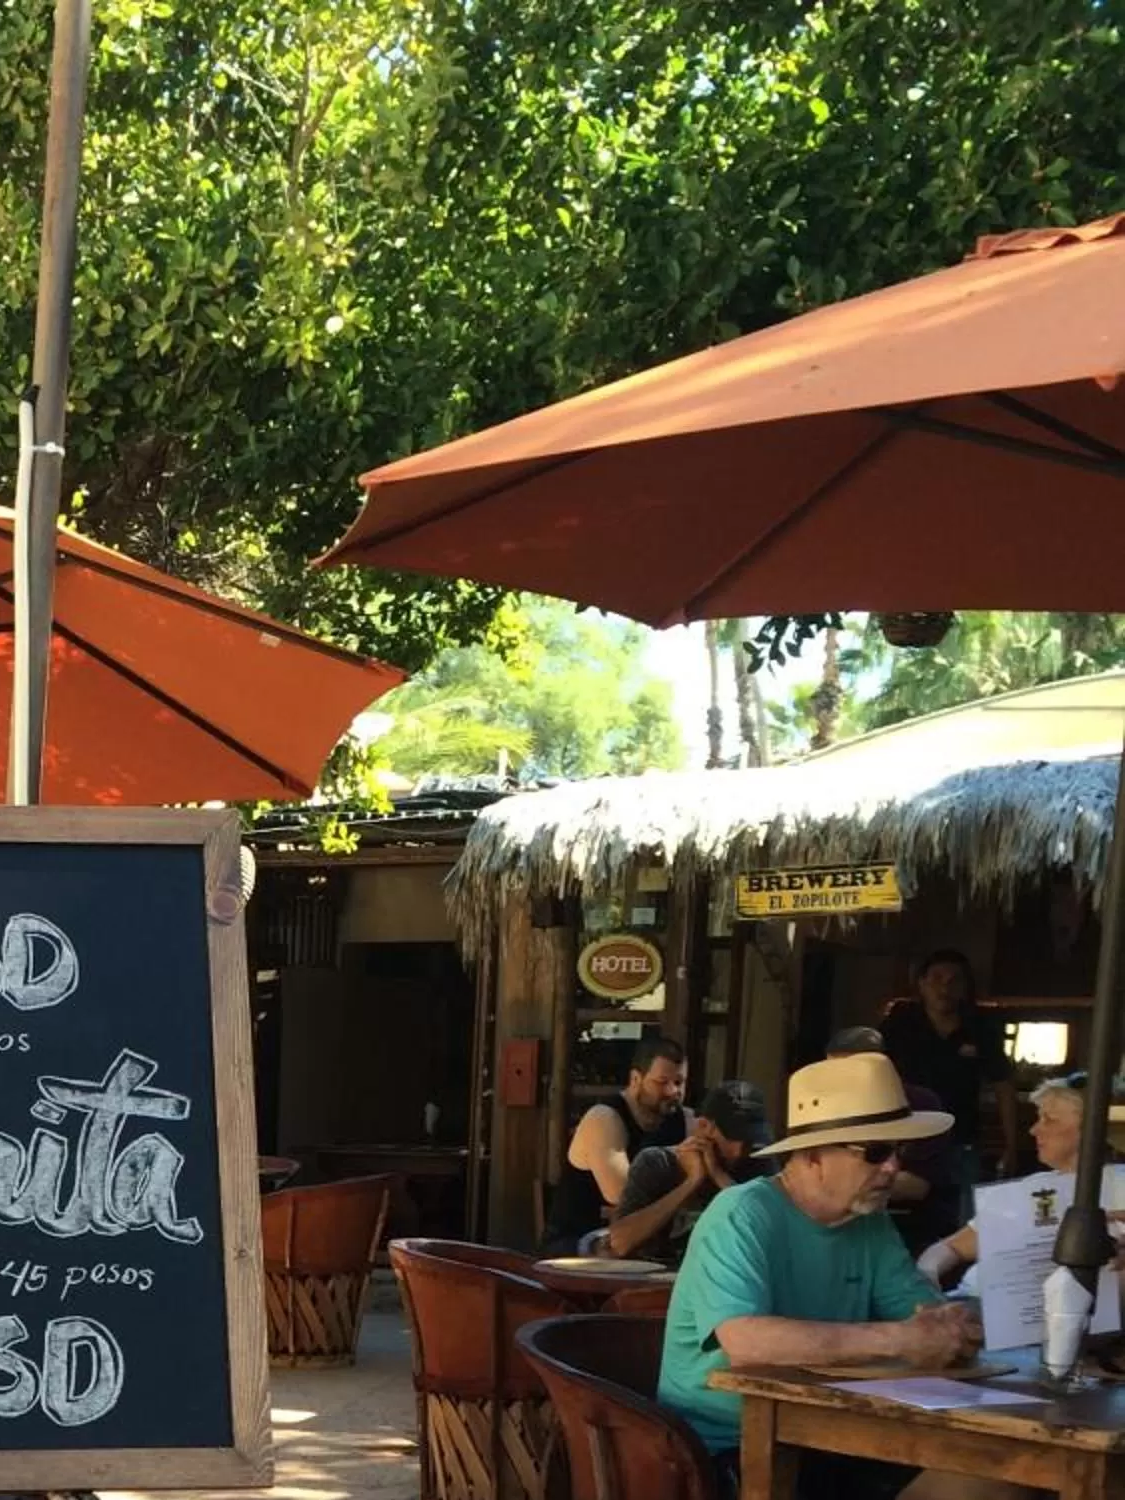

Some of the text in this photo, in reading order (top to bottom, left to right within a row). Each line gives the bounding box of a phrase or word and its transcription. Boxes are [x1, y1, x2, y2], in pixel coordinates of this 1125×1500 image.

[747, 867, 890, 893] BREWERY
[792, 890, 861, 910] ZOPILOTE
[591, 955, 652, 974] HOTEL
[60, 1262, 155, 1301] pesos
